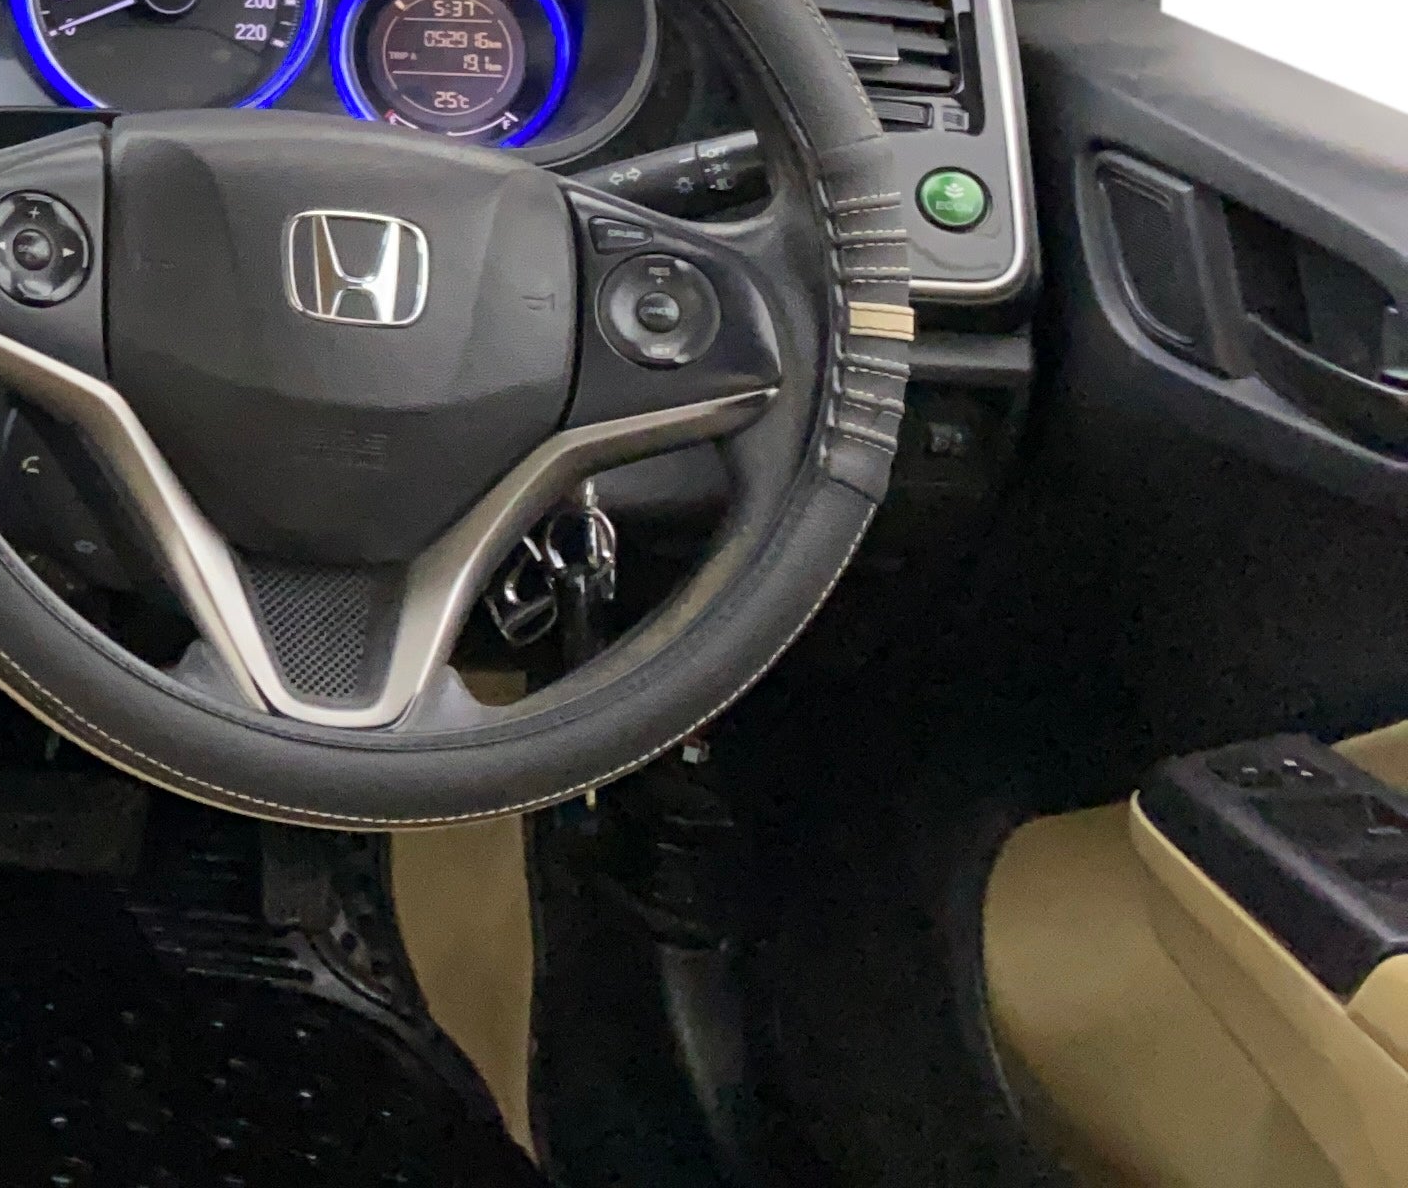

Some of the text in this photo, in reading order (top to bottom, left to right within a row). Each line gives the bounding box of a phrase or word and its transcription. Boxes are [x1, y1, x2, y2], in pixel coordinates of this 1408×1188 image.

[433, 0, 475, 17] 5:37
[235, 24, 267, 41] 220
[388, 51, 409, 60] TRIP
